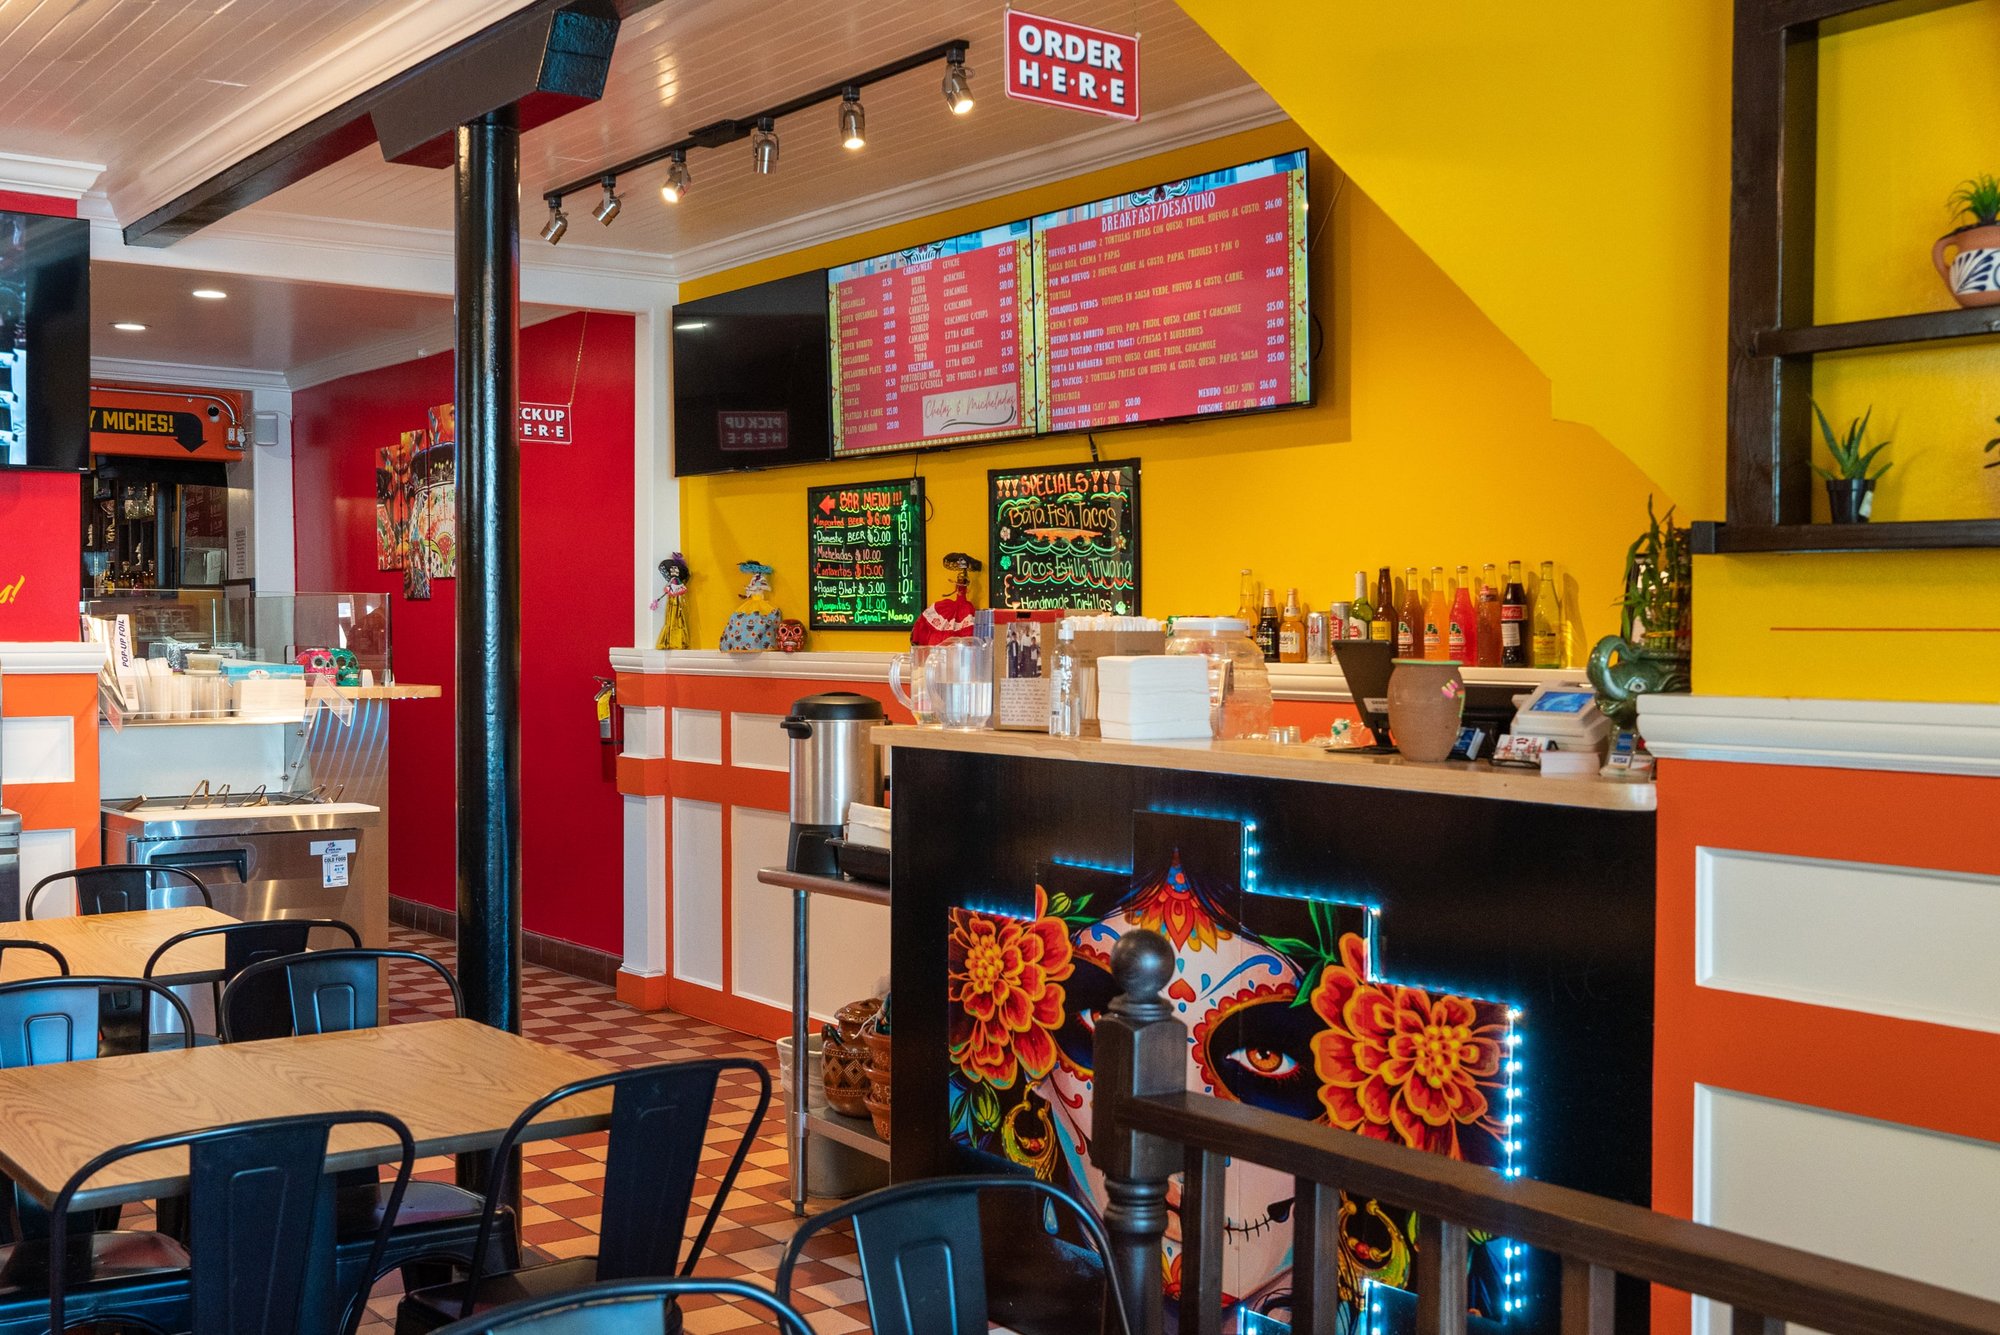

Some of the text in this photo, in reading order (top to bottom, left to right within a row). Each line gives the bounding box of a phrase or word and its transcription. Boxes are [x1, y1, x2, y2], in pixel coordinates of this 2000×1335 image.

[1019, 24, 1124, 72] ORDER
[1101, 191, 1215, 232] BREAKFAST/DESAYUNO
[103, 410, 174, 433] MICHES!
[519, 407, 565, 422] CK UP
[1021, 473, 1089, 496] SPECIALS
[840, 492, 859, 509] BAR
[863, 491, 890, 507] MENU
[1009, 501, 1118, 531] Baja Fish Tacos
[817, 530, 843, 543] Domestic
[847, 531, 866, 542] BEER
[817, 545, 853, 560] Micheladas
[1012, 553, 1054, 577] Tacos
[818, 581, 837, 597] Agave
[839, 581, 857, 595] Shot
[1021, 593, 1113, 612] Handmade Tortillas
[888, 609, 914, 623] Mango
[117, 619, 129, 668] POP-UP FOIL
